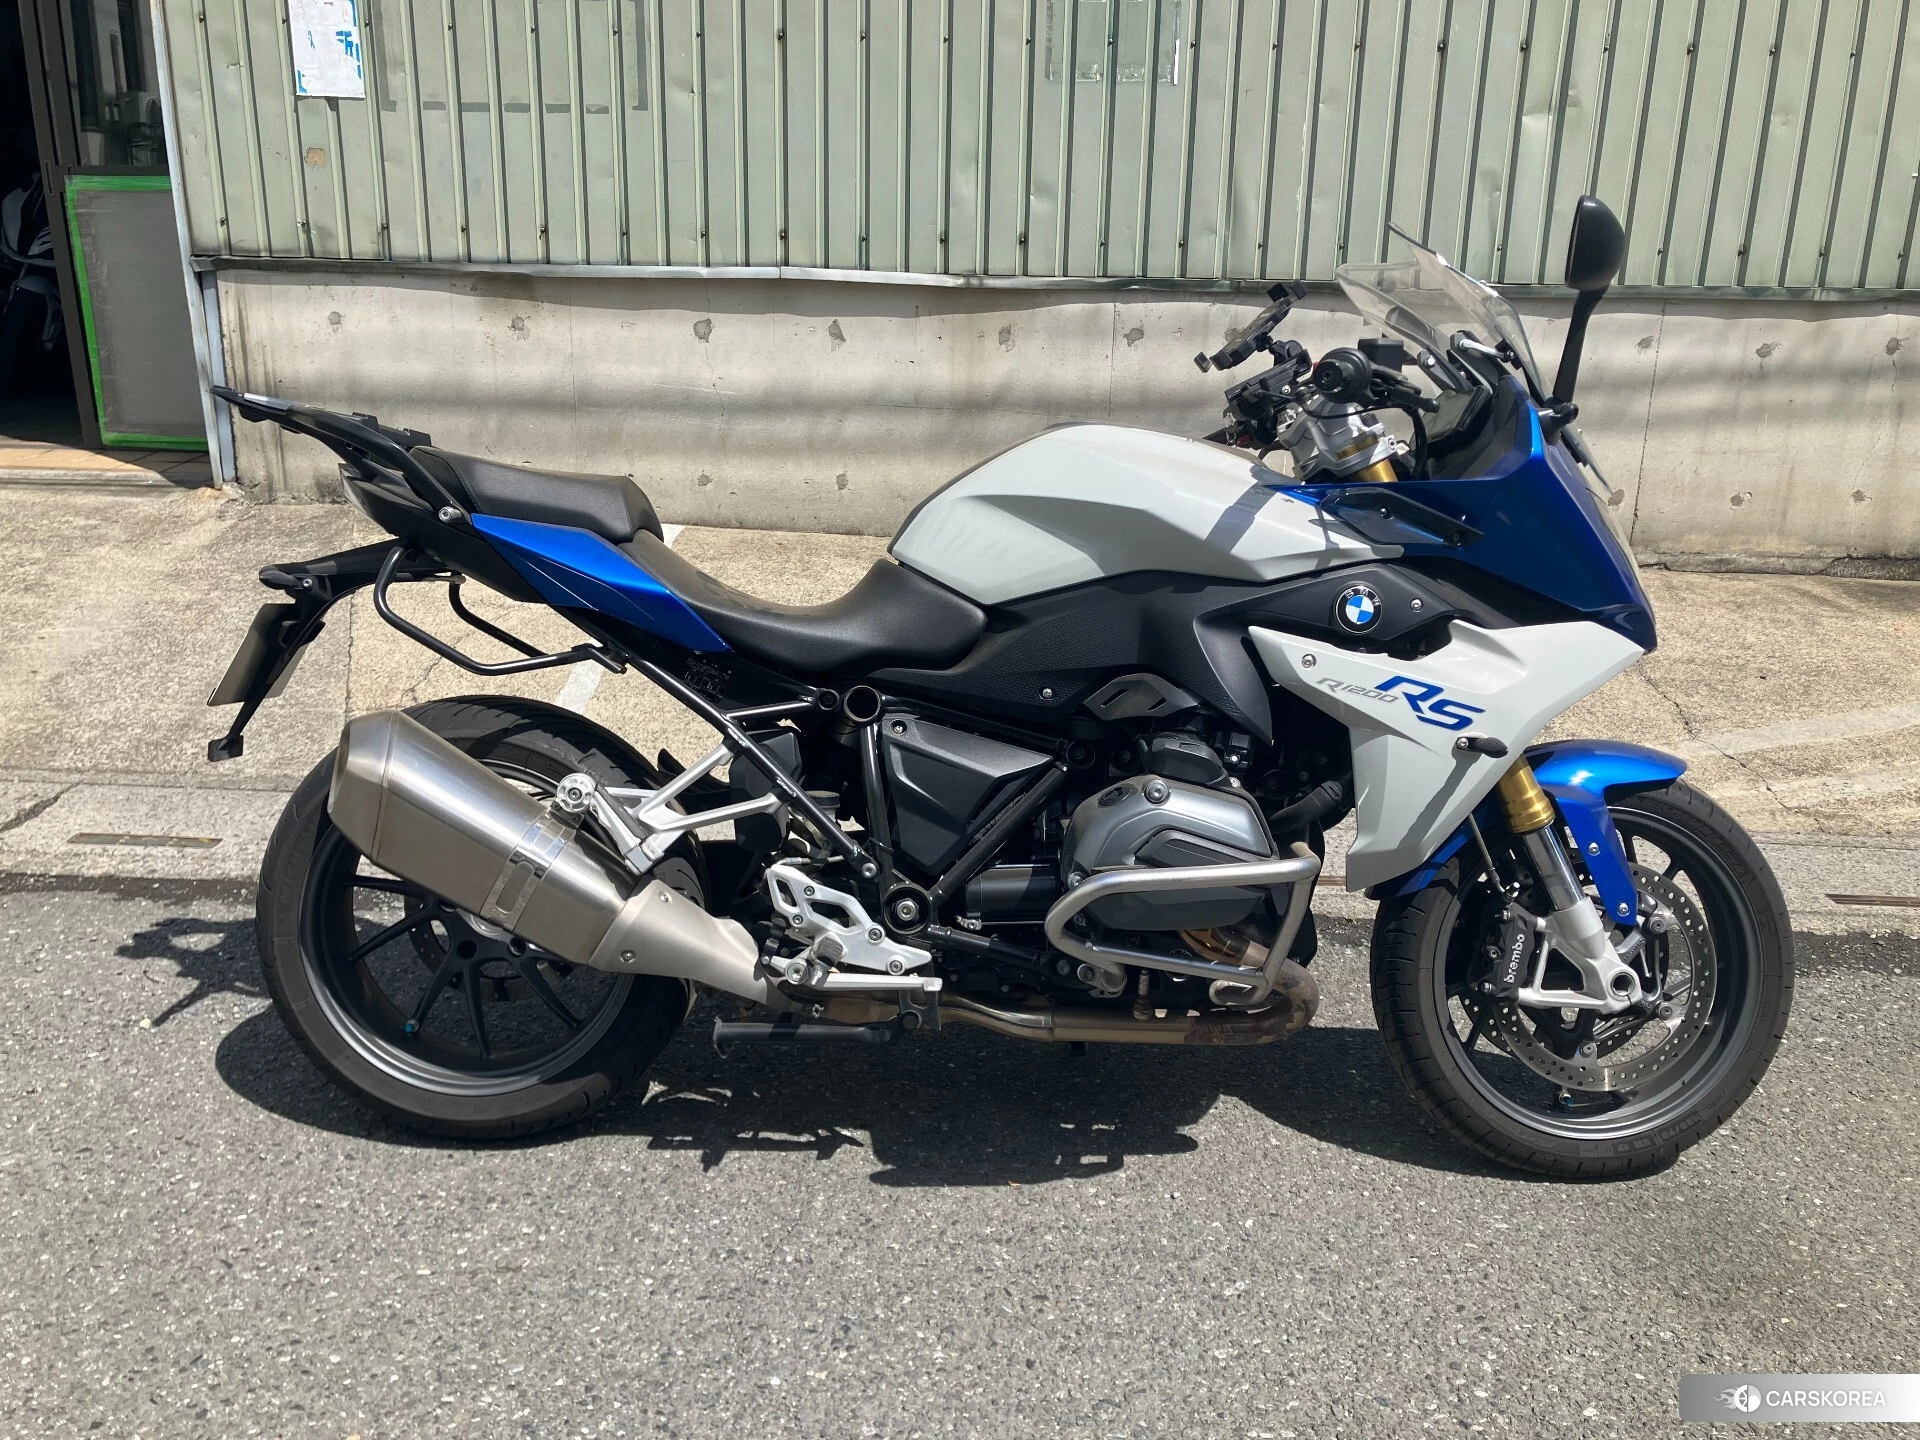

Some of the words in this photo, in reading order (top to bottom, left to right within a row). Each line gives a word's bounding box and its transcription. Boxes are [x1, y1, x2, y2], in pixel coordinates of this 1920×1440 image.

[1345, 588, 1381, 606] BMW
[1374, 675, 1486, 731] RS
[1503, 933, 1525, 983] brembo
